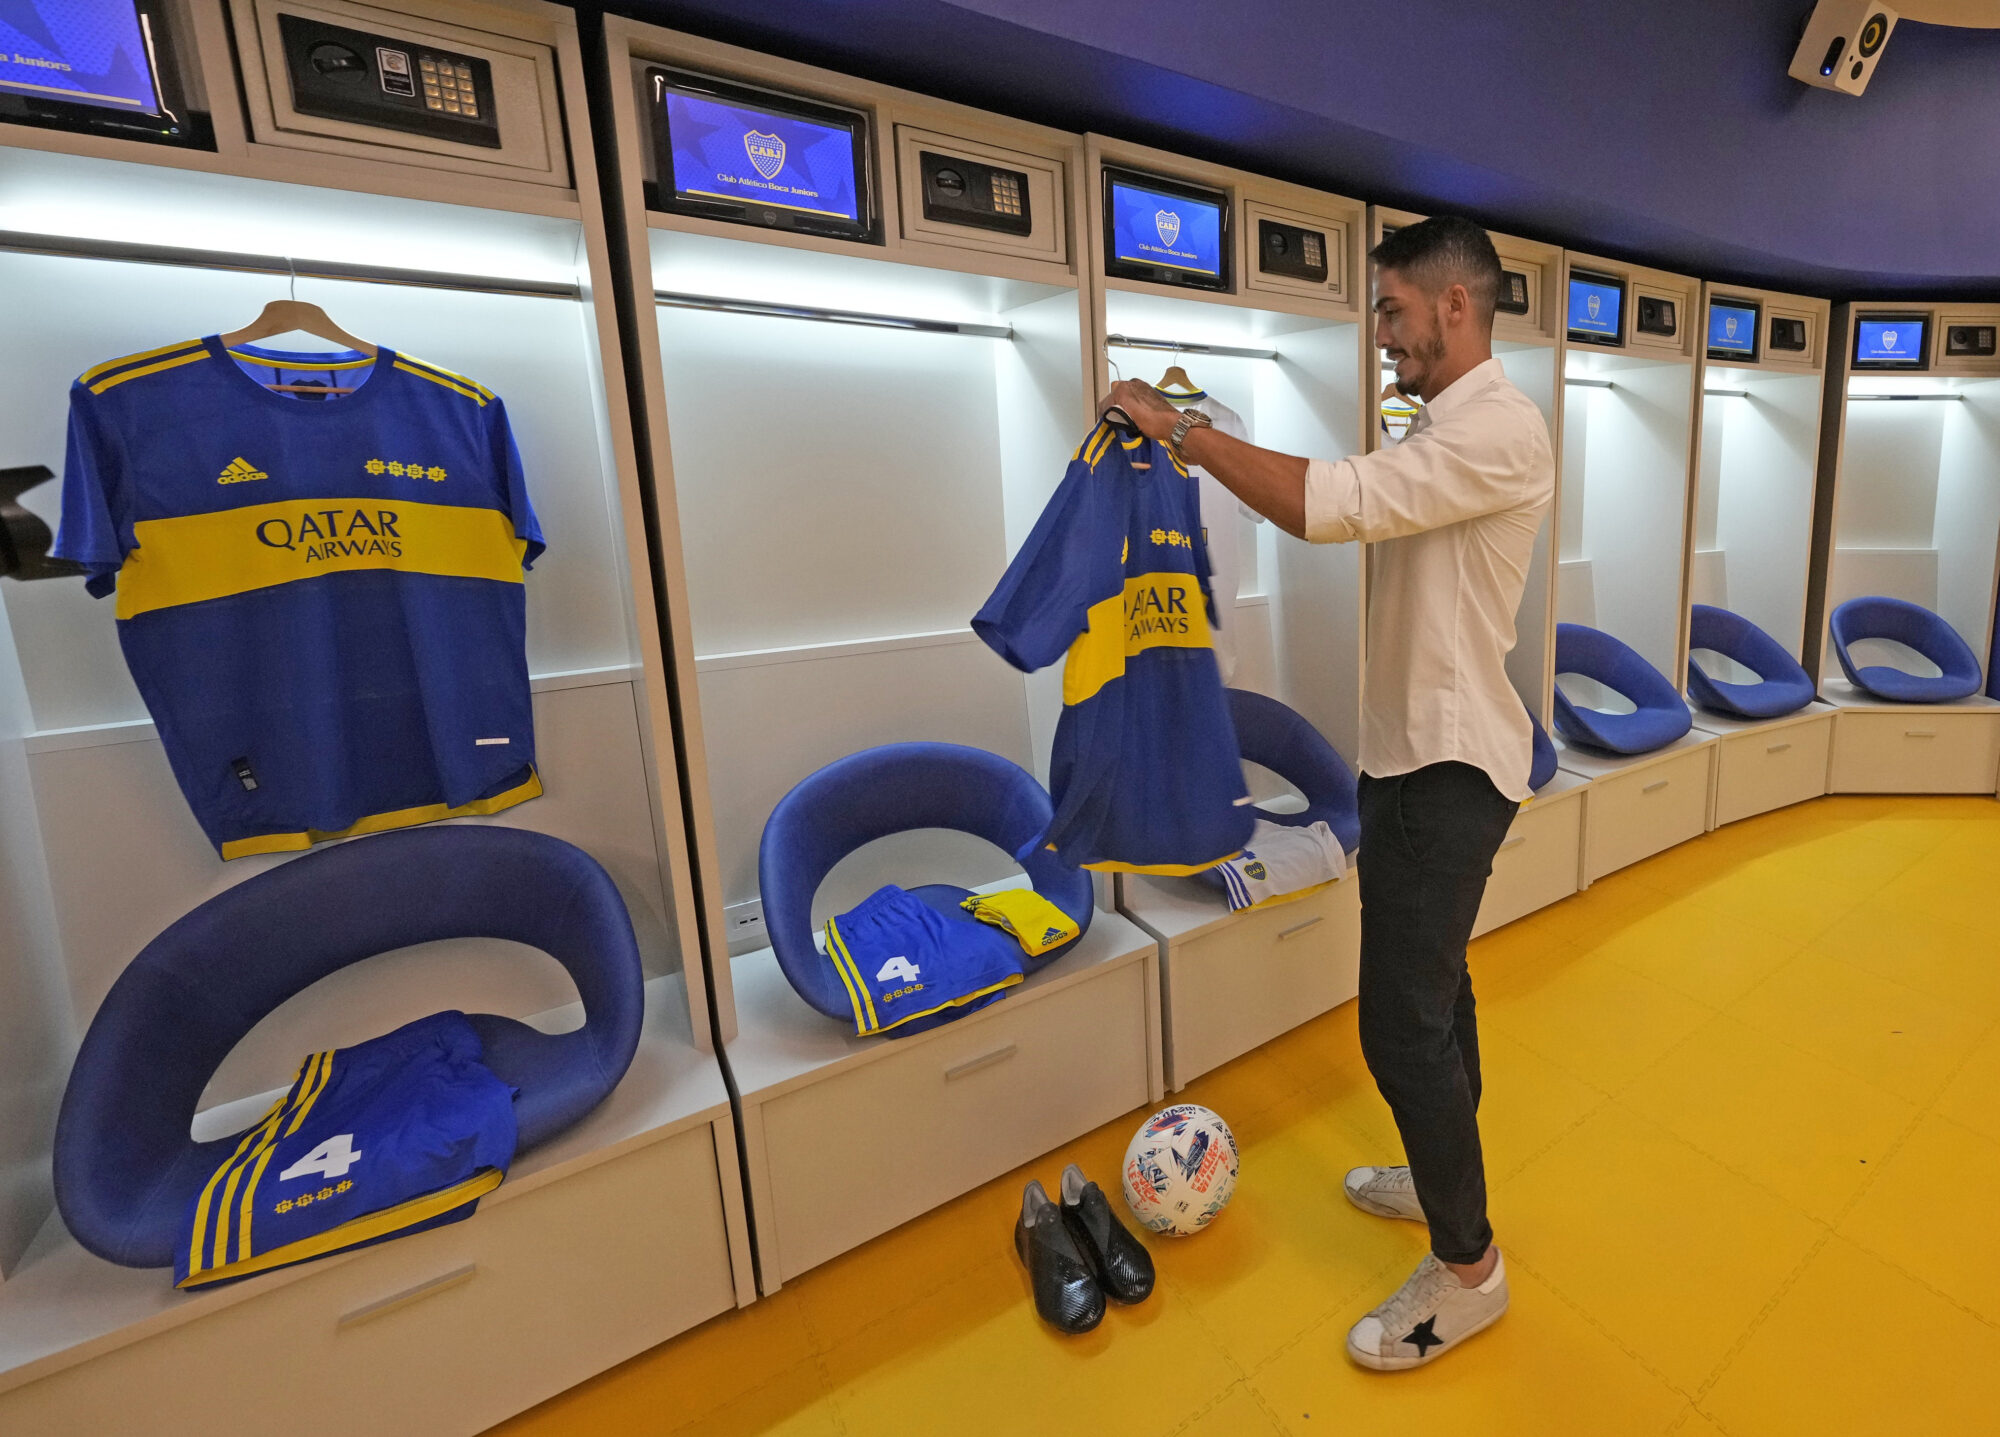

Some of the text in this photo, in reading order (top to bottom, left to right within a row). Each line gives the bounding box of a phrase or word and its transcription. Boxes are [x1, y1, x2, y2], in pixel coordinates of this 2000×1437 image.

[13, 53, 72, 71] Juniors
[750, 145, 781, 159] CABJ
[717, 173, 737, 184] Club
[768, 182, 789, 193] Boca
[790, 187, 819, 198] Juniors
[217, 472, 269, 485] adidas
[256, 509, 402, 551] QATAR
[306, 539, 403, 563] AIRWAYS
[1124, 586, 1189, 620] ATAR
[1041, 931, 1068, 946] adidas
[876, 955, 921, 983] 4
[280, 1133, 362, 1181] 4
